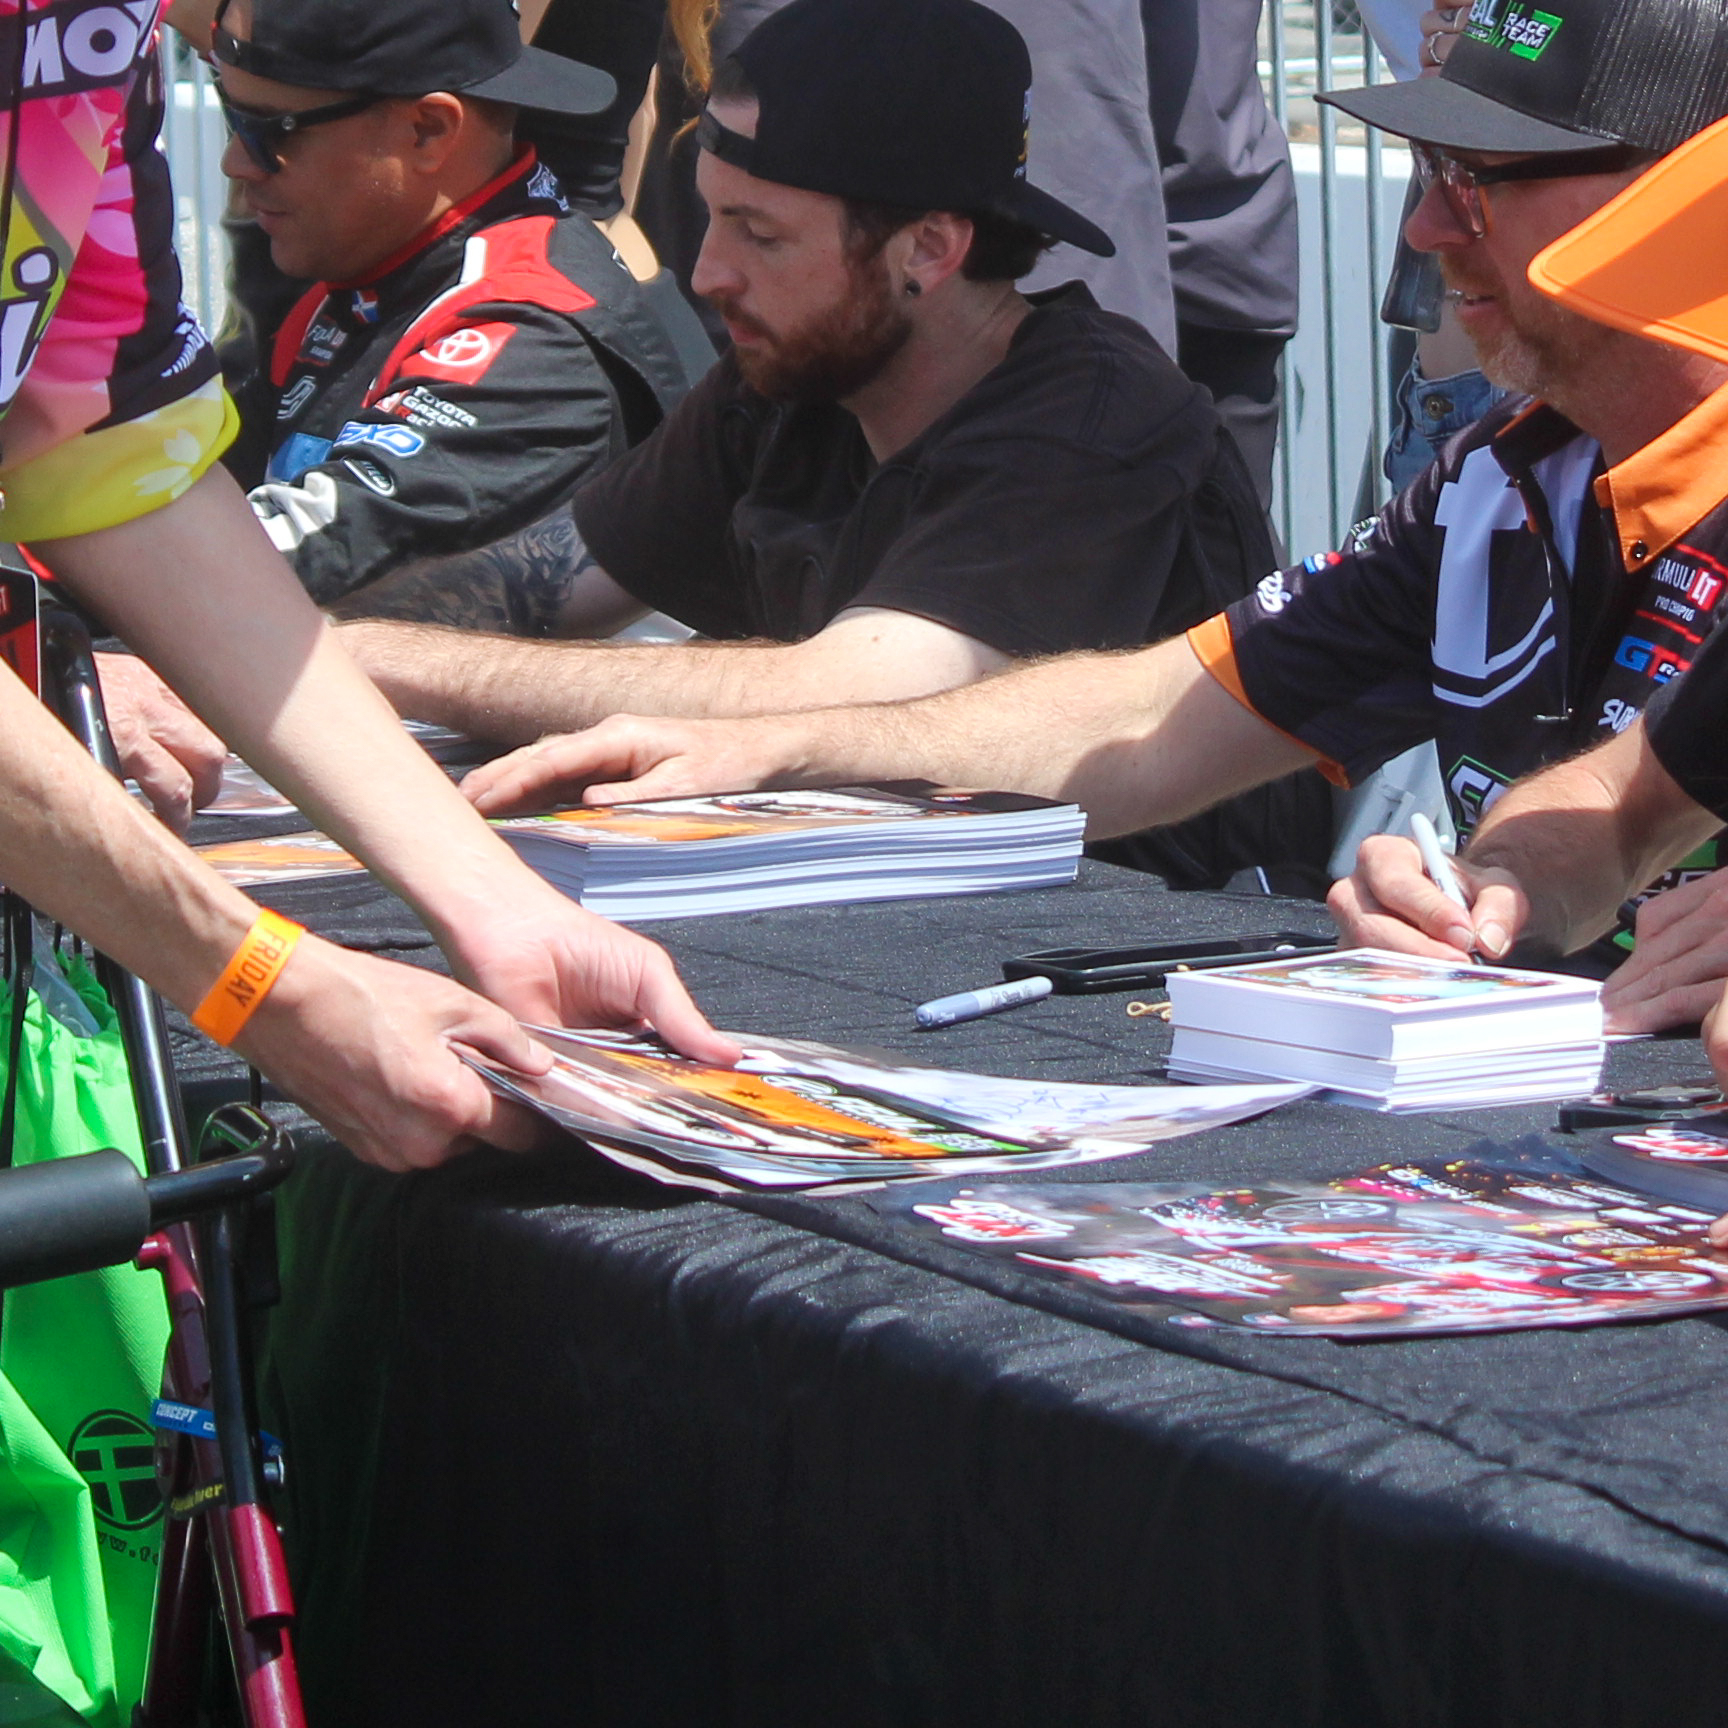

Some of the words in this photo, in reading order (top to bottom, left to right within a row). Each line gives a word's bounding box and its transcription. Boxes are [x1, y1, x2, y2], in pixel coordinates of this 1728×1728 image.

[1502, 23, 1544, 49] TEAM
[1505, 12, 1551, 38] RACE
[414, 385, 478, 427] TOYOTA
[225, 927, 288, 1008] FRIDAY
